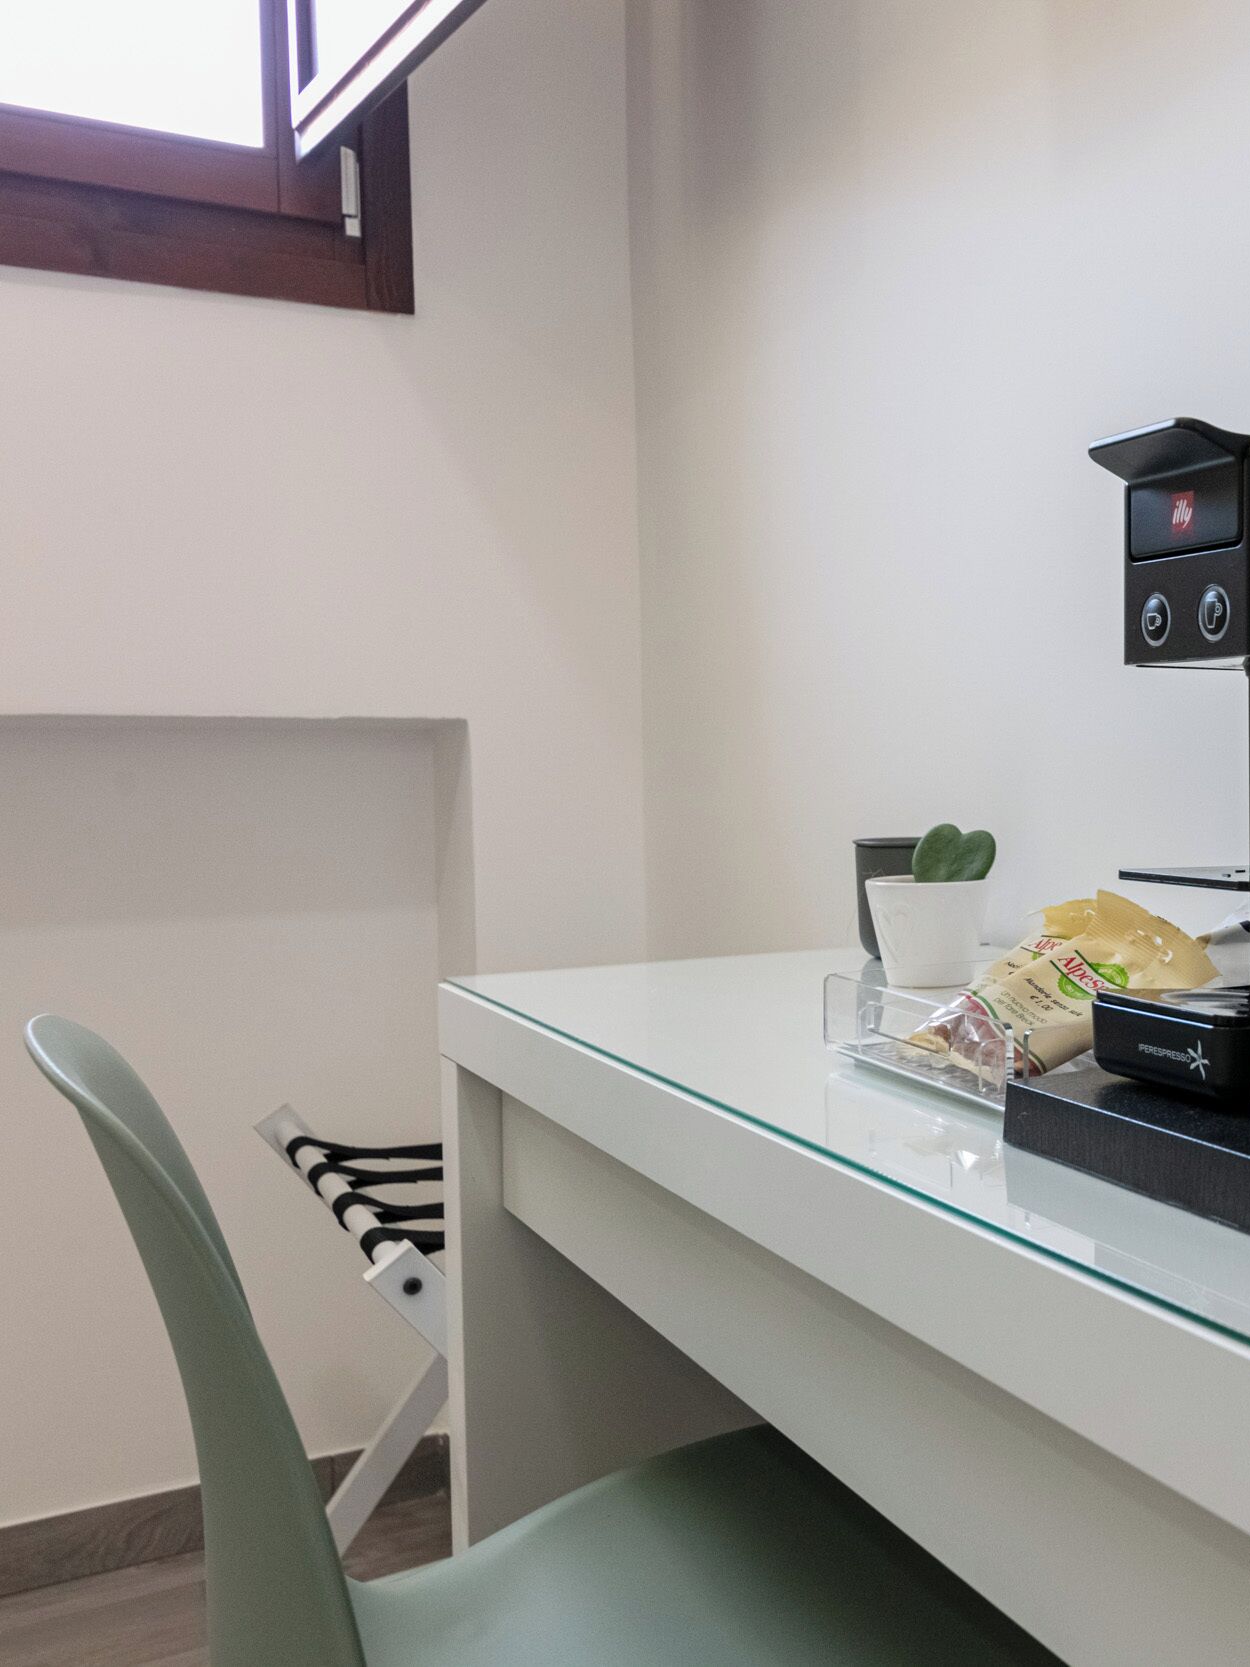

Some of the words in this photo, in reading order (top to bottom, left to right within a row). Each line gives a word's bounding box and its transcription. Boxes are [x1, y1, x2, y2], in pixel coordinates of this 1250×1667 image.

[1172, 498, 1193, 529] illy
[1057, 956, 1105, 991] AlpeS
[1138, 1043, 1191, 1063] IPERESPRESSO
